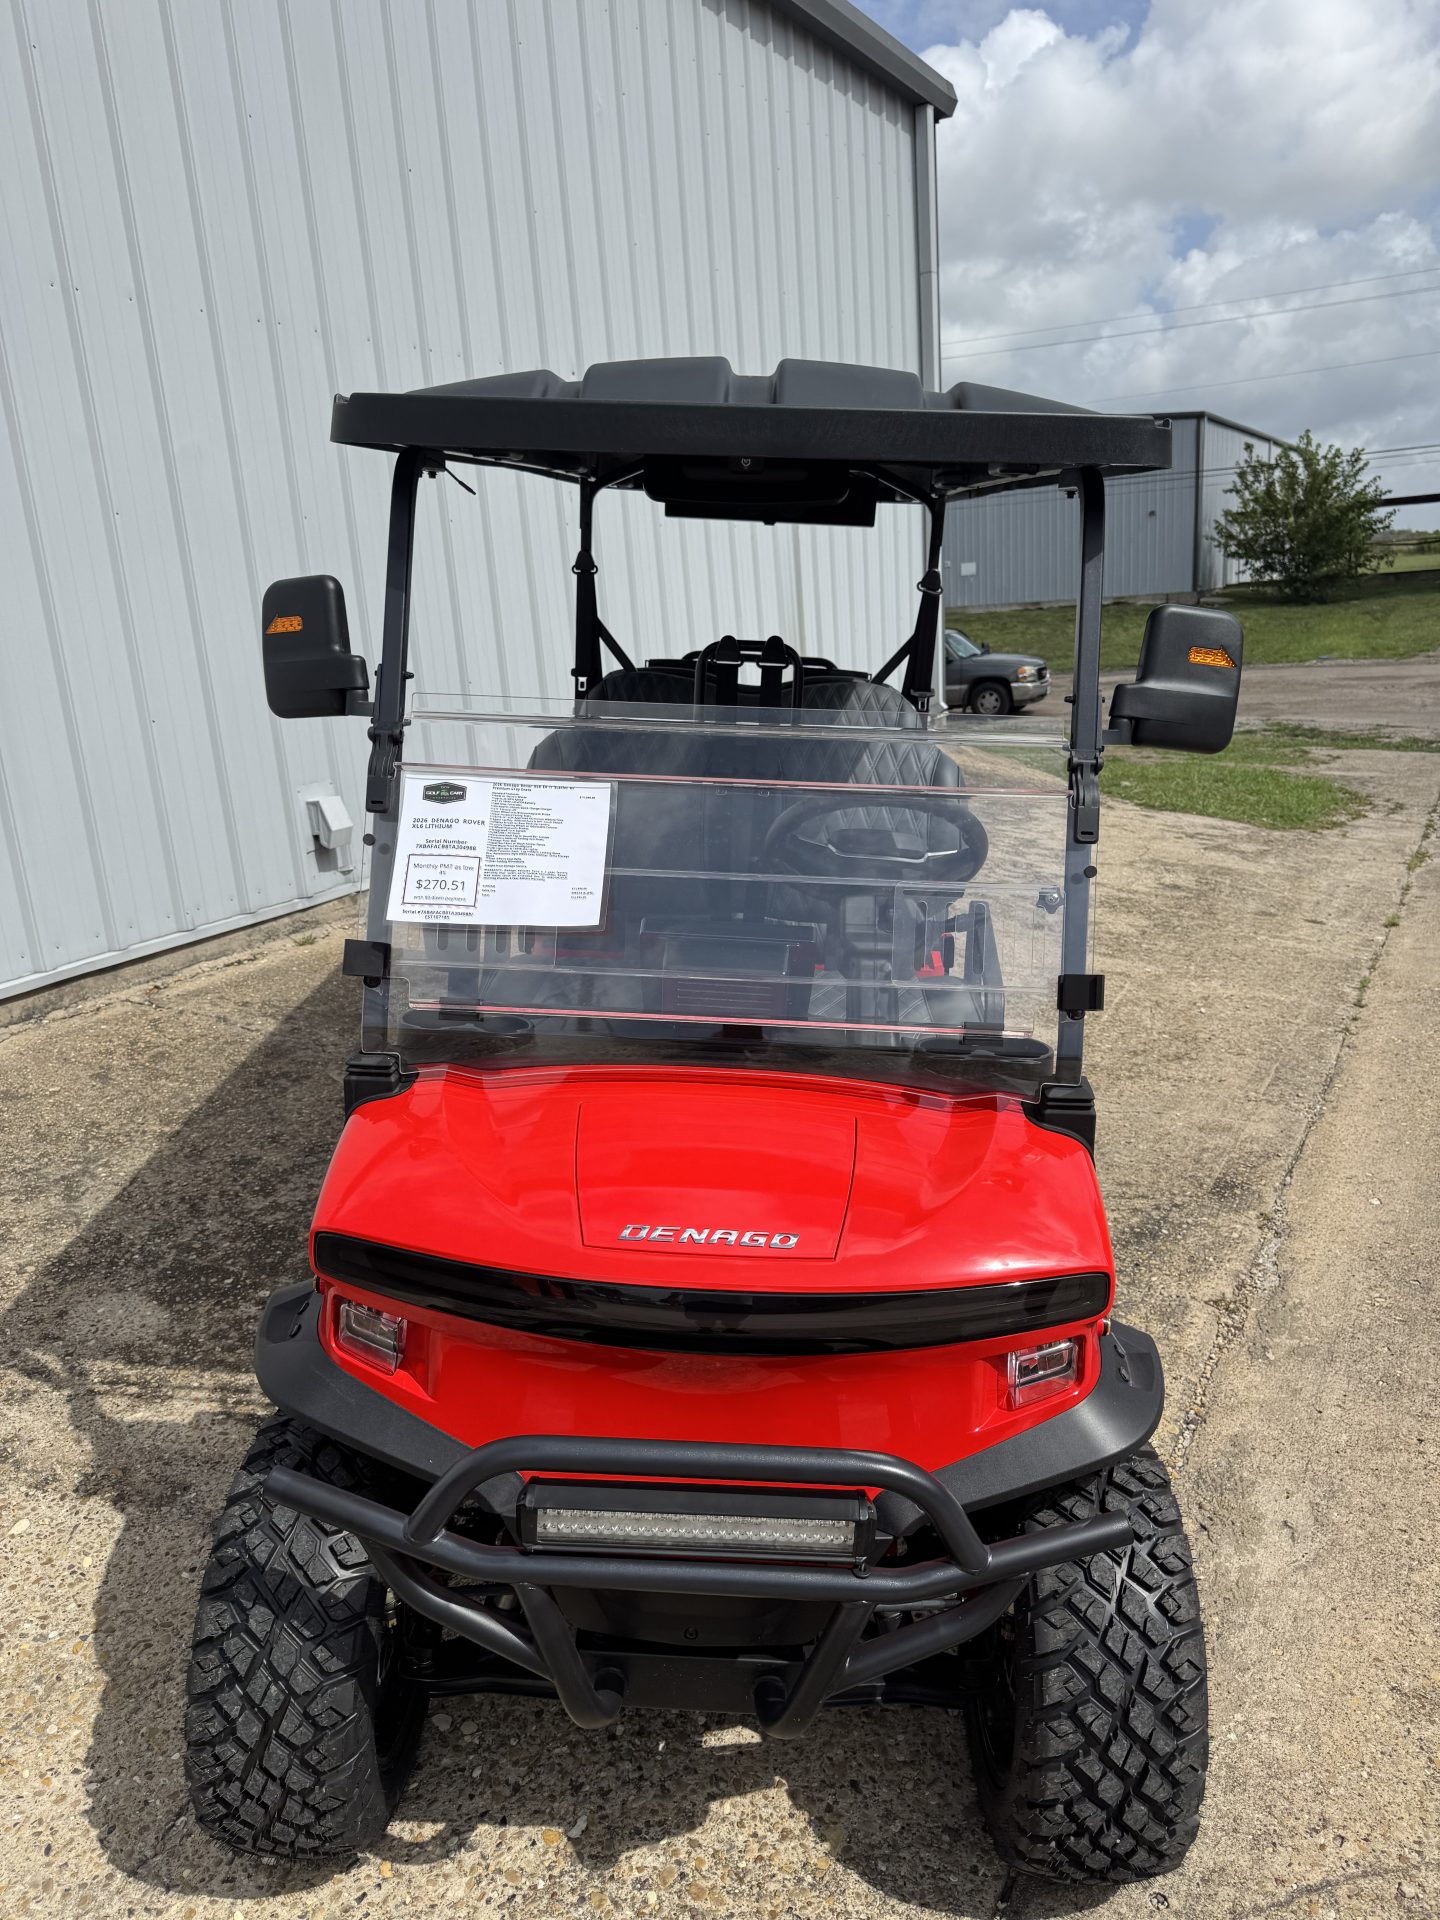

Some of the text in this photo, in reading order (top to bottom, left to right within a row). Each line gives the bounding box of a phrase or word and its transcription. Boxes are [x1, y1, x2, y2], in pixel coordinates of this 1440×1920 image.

[463, 818, 486, 826] ROVER
[415, 879, 465, 892] $270.51
[617, 1224, 801, 1249] DENAGO
